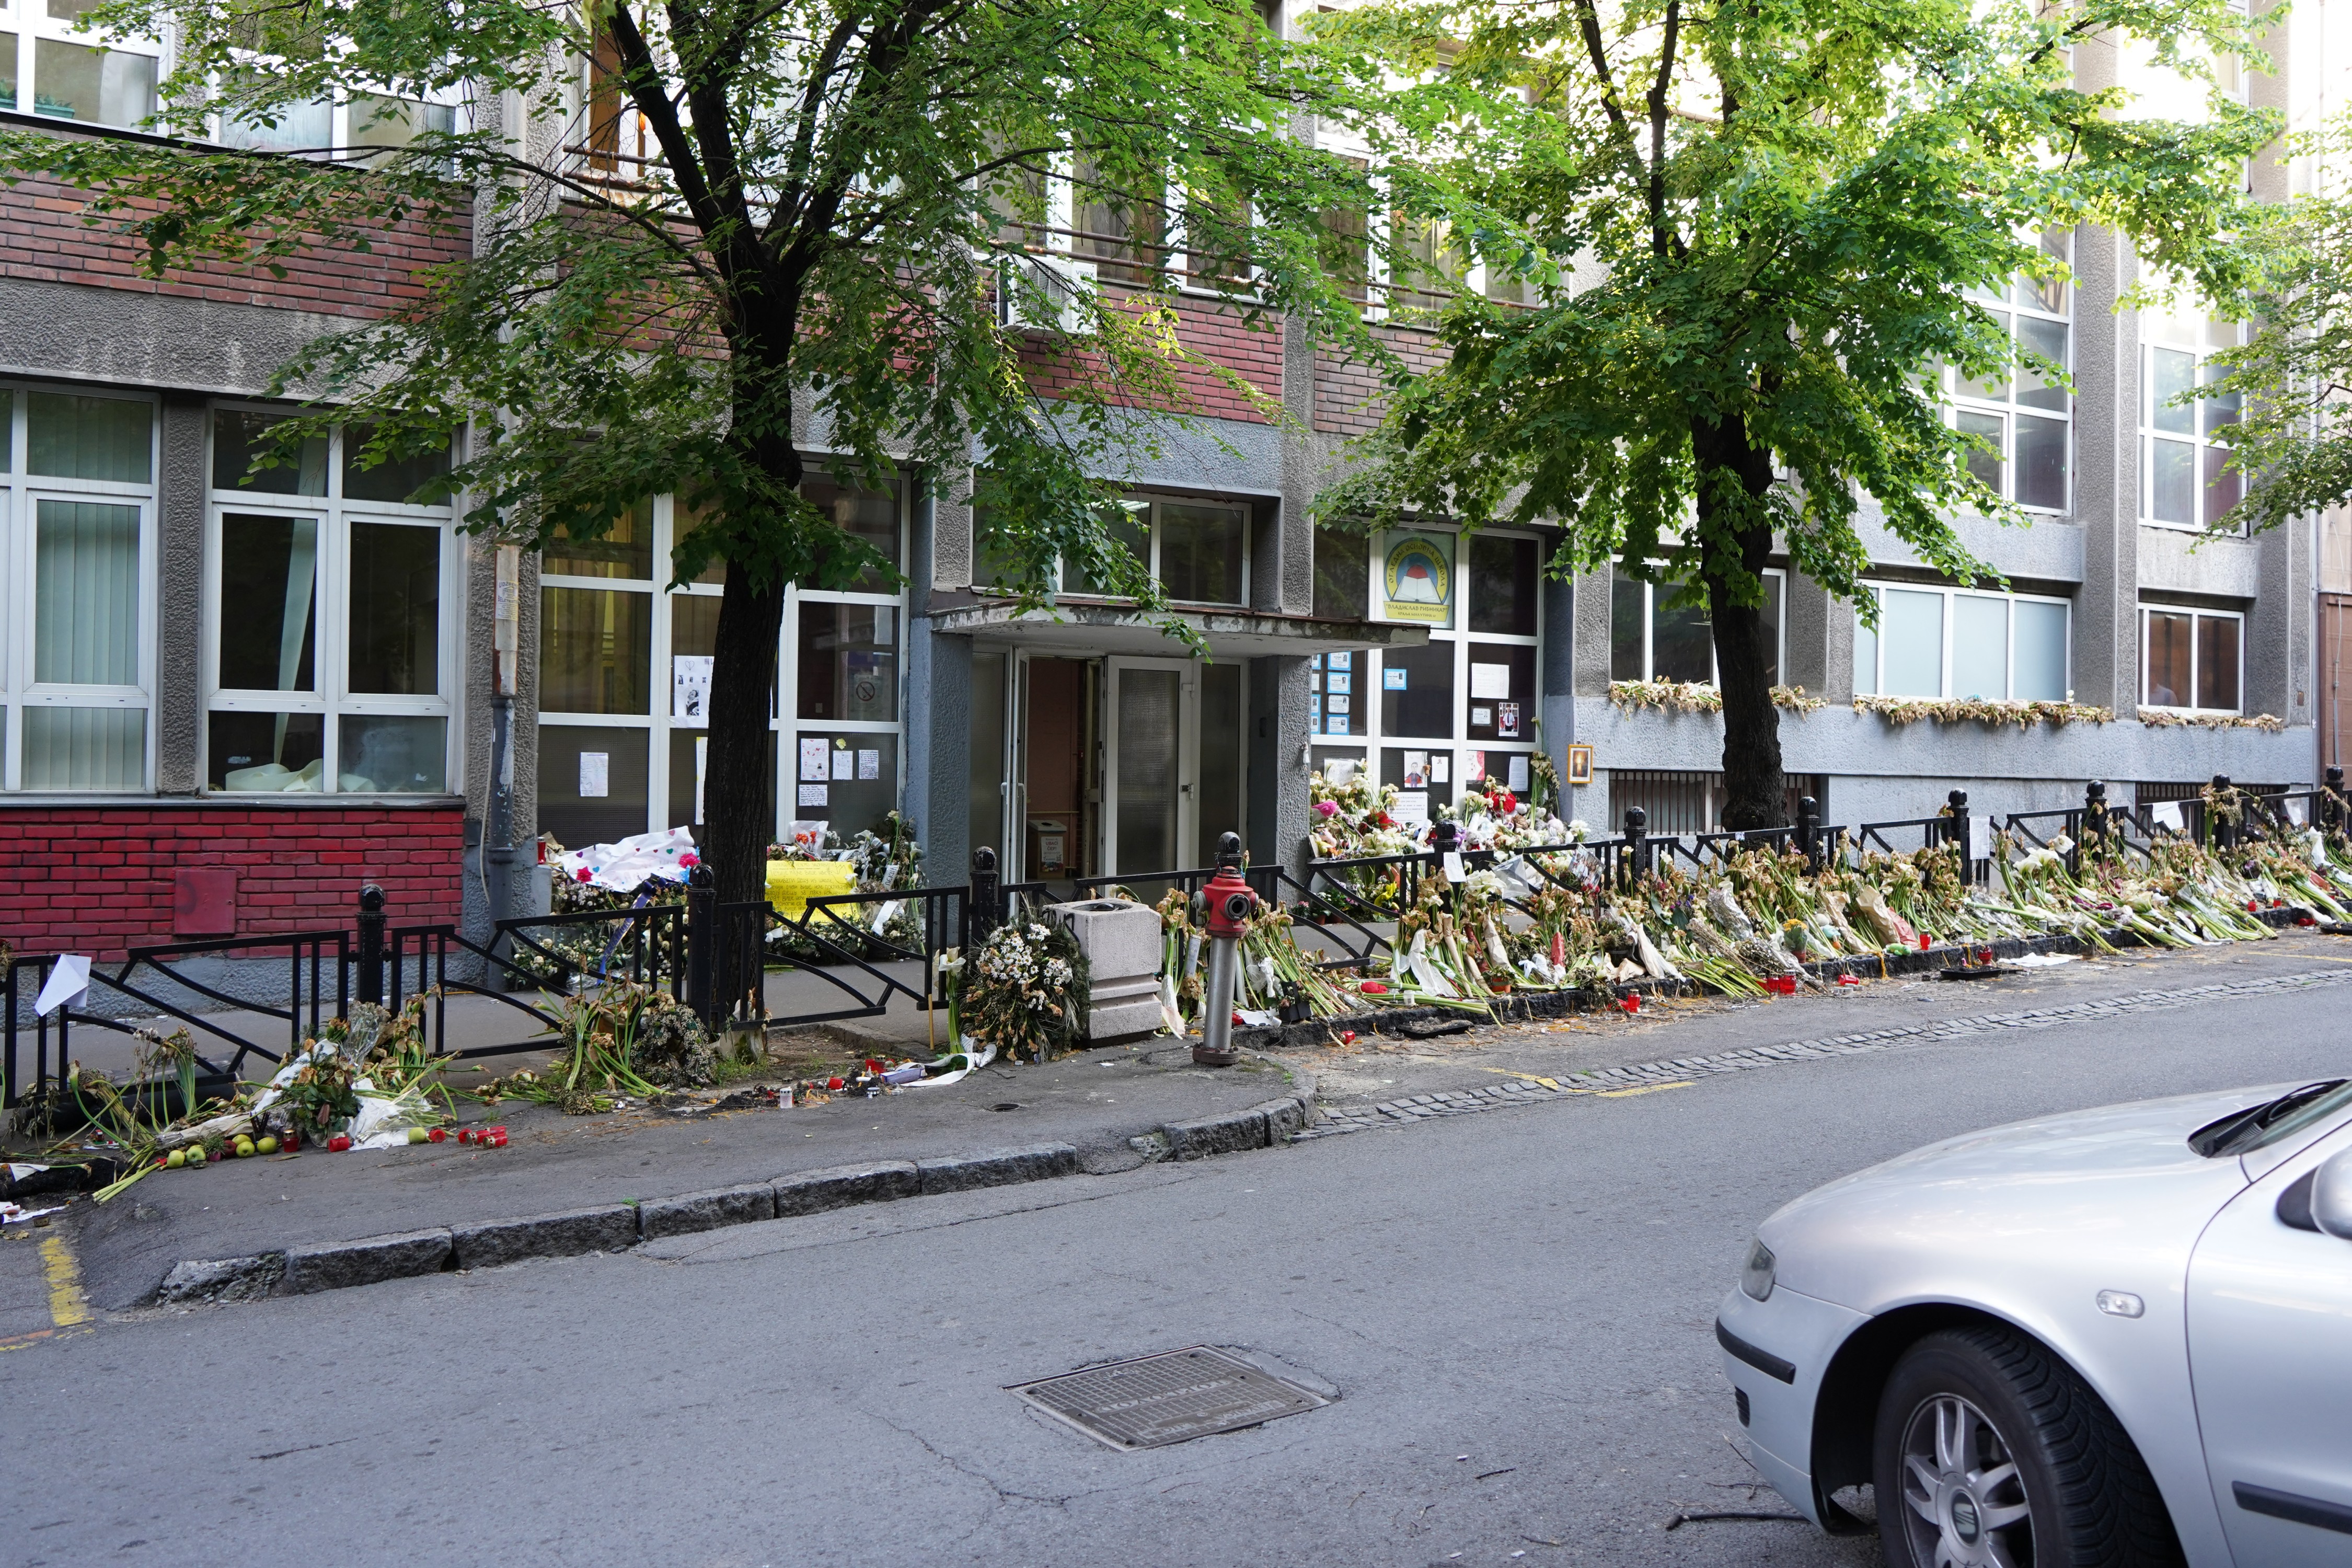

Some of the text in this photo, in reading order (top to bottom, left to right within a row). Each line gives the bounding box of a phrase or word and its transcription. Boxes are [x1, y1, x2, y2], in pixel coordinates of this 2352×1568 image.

[1389, 544, 1445, 586] ОГЛЕДНА ОСНОВНА ШКОЛА
[1099, 1379, 1229, 1412] TOPLOVOD
